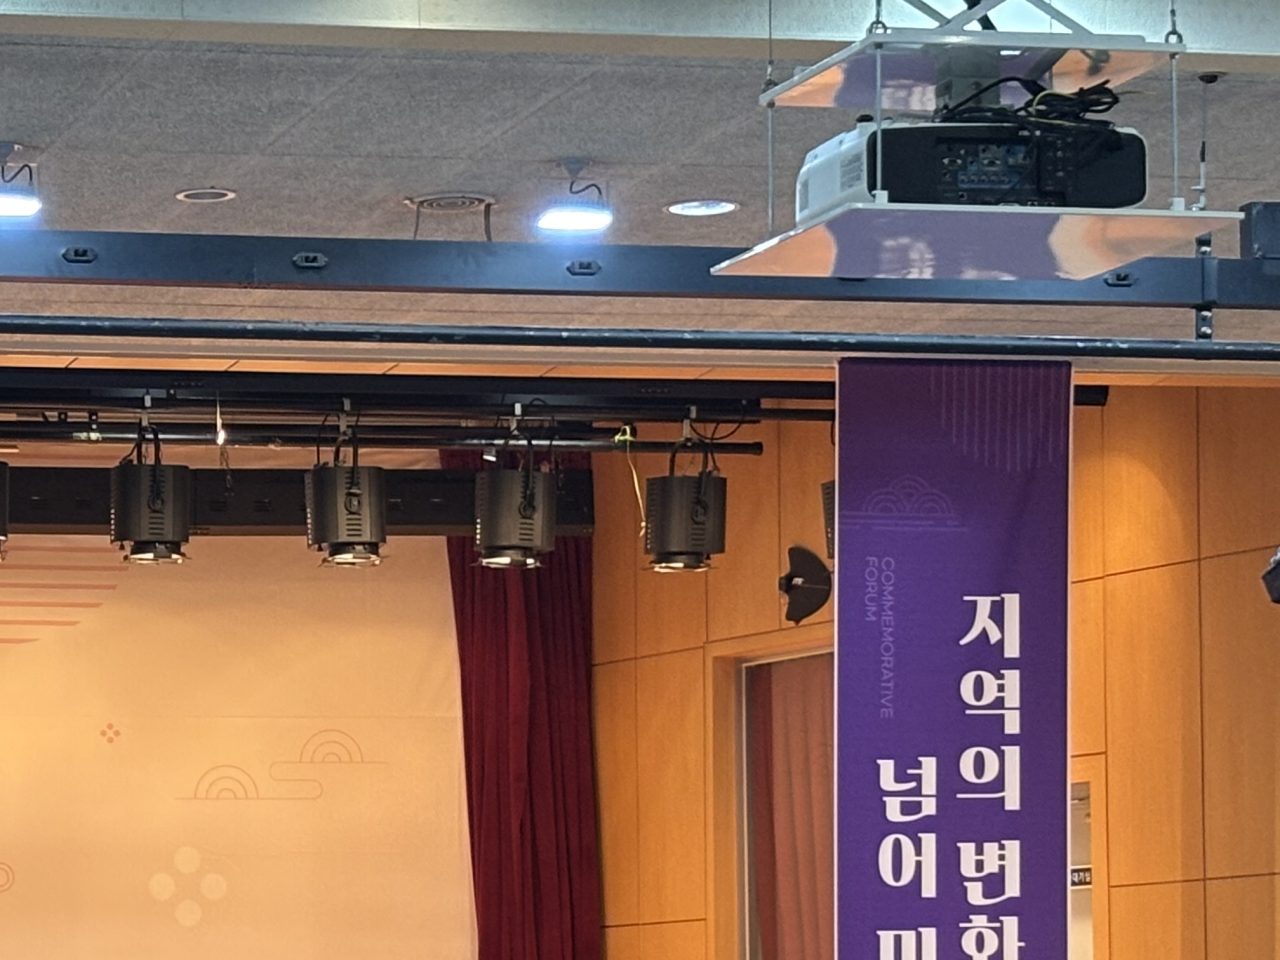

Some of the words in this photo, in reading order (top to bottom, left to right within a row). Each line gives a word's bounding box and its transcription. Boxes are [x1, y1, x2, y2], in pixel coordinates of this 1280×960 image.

[864, 556, 878, 622] FORUM
[880, 556, 895, 719] COMMEMORATIVE
[956, 593, 1021, 811] 지역의
[876, 756, 937, 898] 넘어
